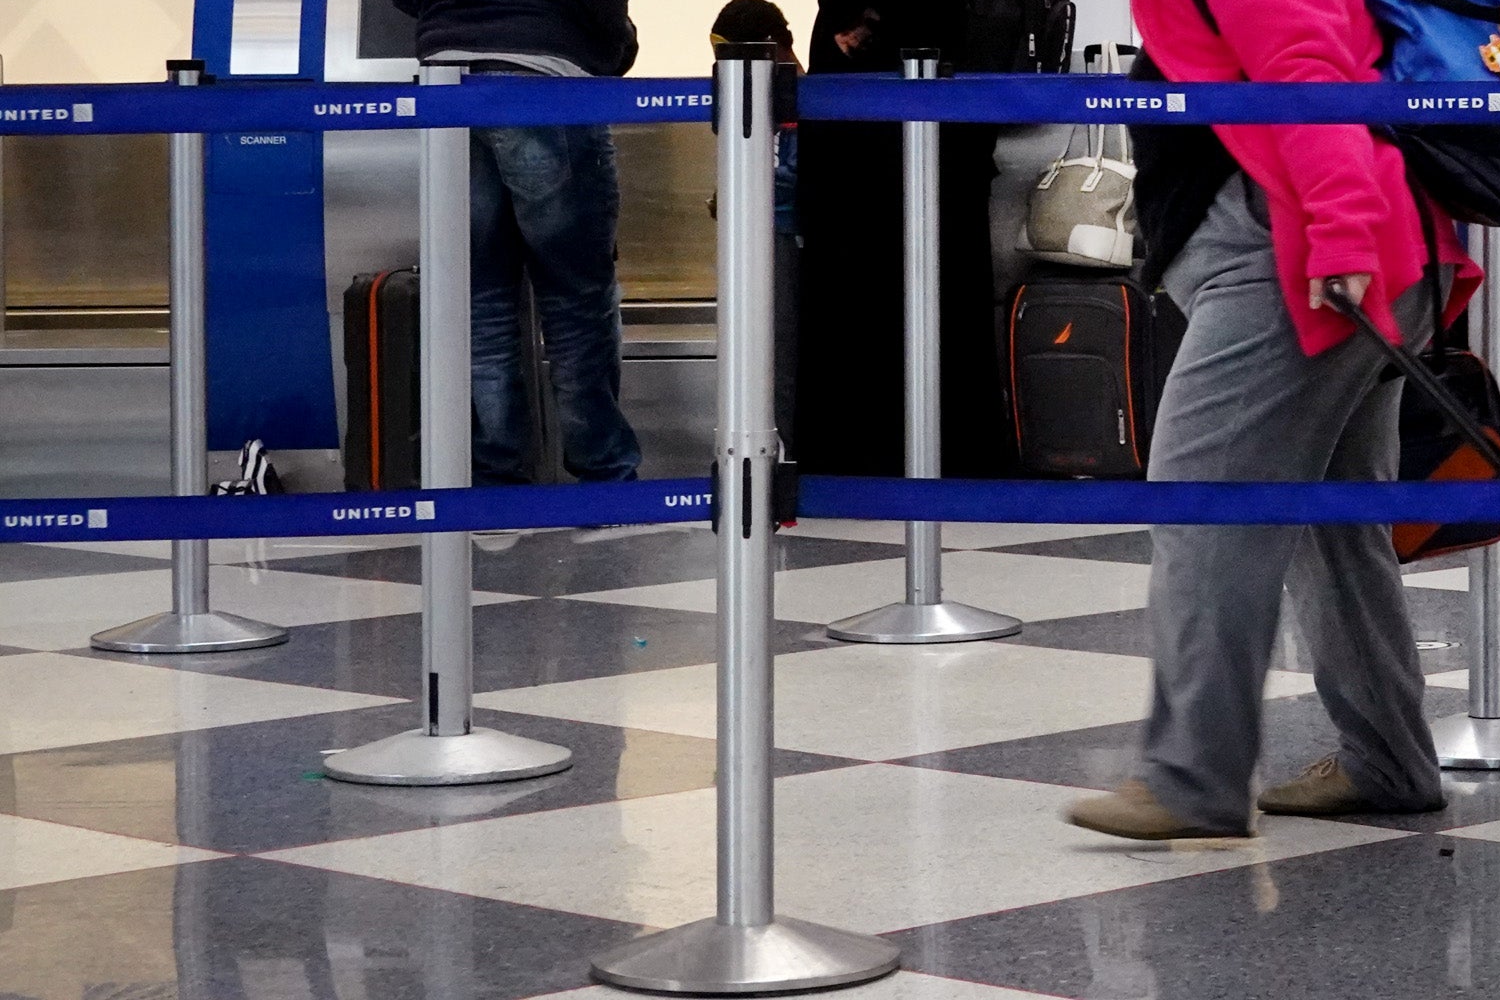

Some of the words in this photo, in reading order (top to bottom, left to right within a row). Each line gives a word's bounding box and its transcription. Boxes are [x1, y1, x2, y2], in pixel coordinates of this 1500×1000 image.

[636, 95, 713, 107] UNITED
[1085, 97, 1163, 109] UNITED
[1407, 97, 1484, 110] UNITED
[0, 109, 69, 121] NITED
[314, 102, 392, 116] UNITED
[240, 135, 287, 145] SCANNER
[664, 494, 712, 507] UNIT
[333, 507, 412, 520] UNITED
[4, 515, 84, 527] UNITED
